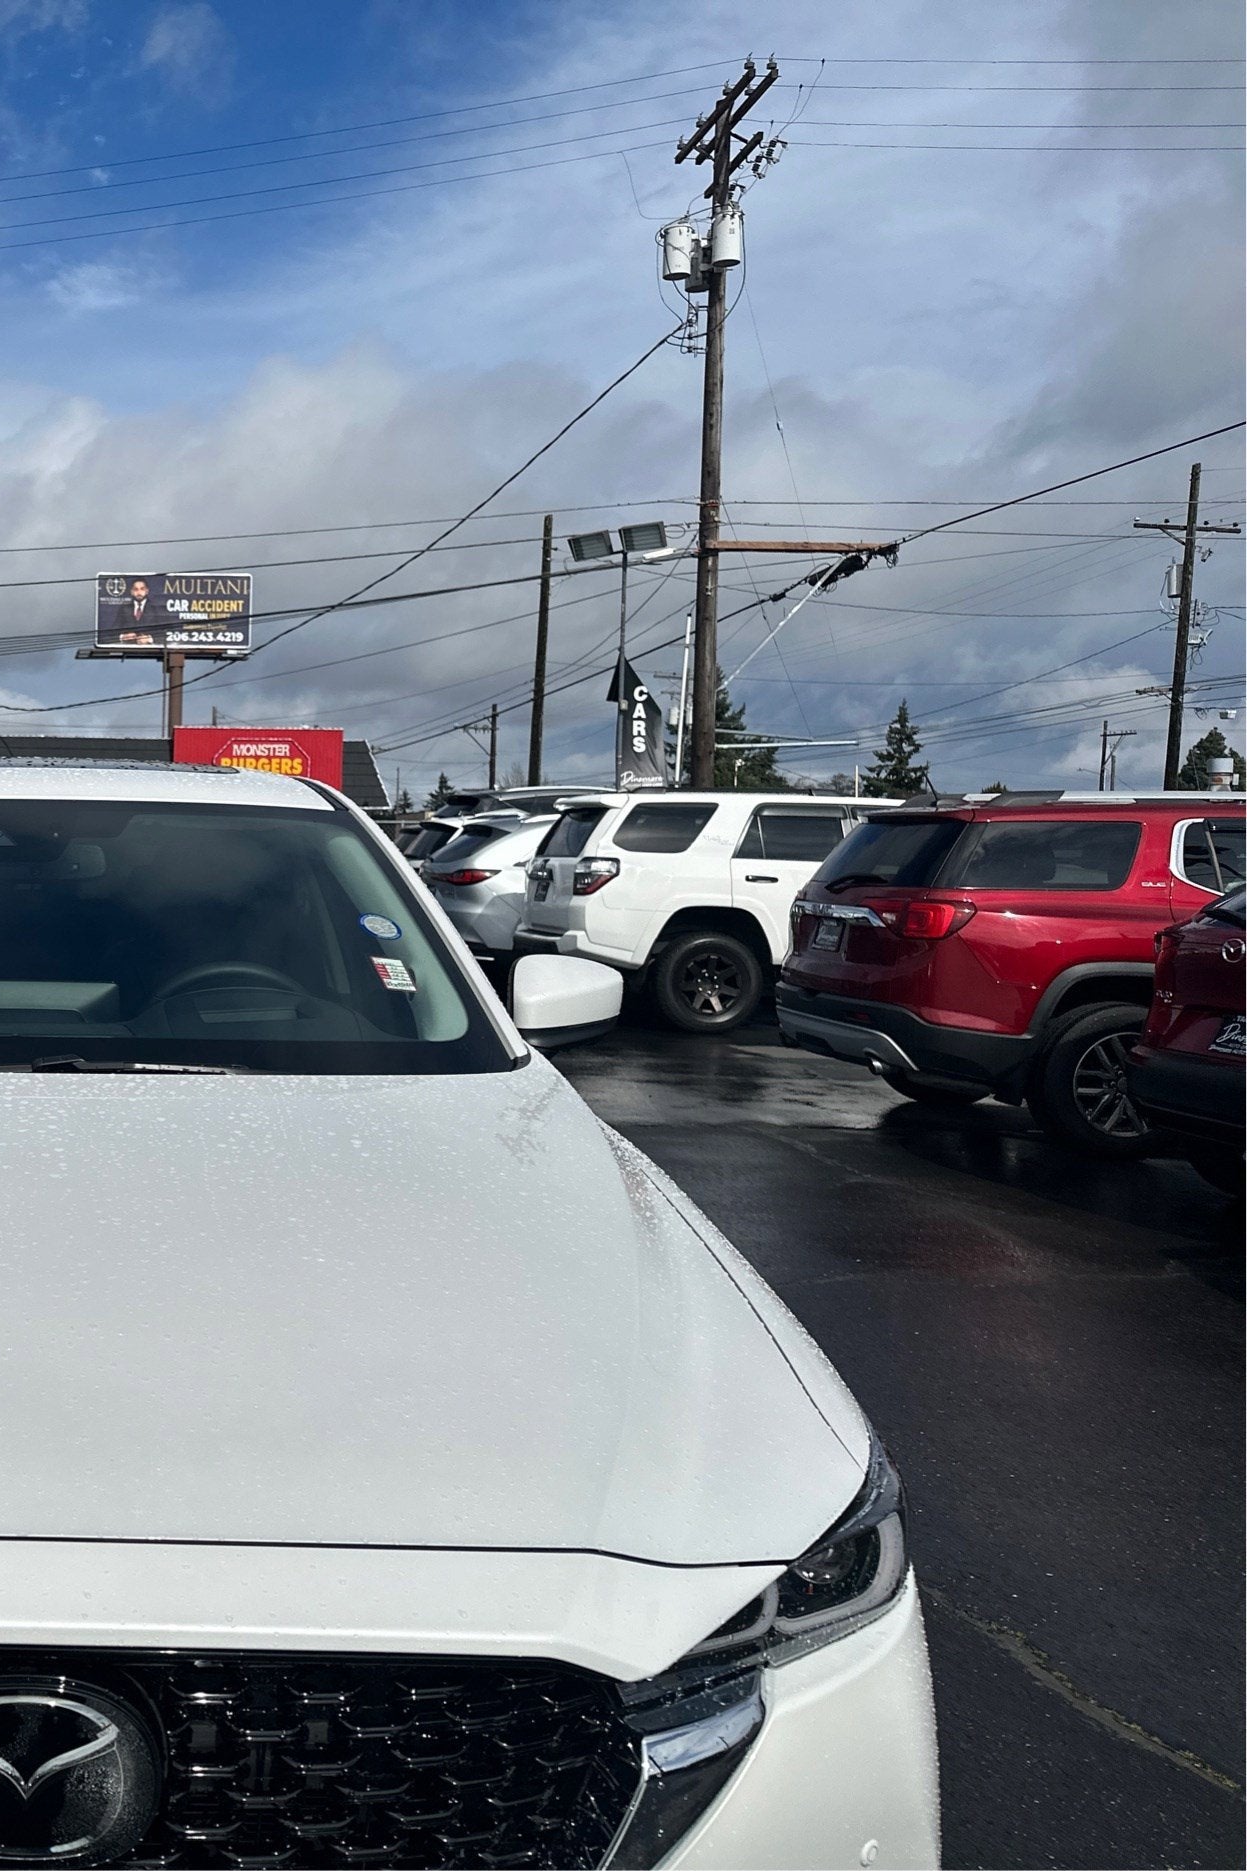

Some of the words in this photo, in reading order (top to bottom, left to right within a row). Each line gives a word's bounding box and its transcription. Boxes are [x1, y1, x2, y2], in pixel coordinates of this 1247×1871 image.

[164, 579, 249, 595] MULTANI
[166, 599, 189, 612] CAR
[191, 600, 245, 613] ACCIDENT
[166, 631, 244, 643] 206.243.4219
[632, 686, 648, 753] CARS
[232, 744, 290, 757] MONSTER
